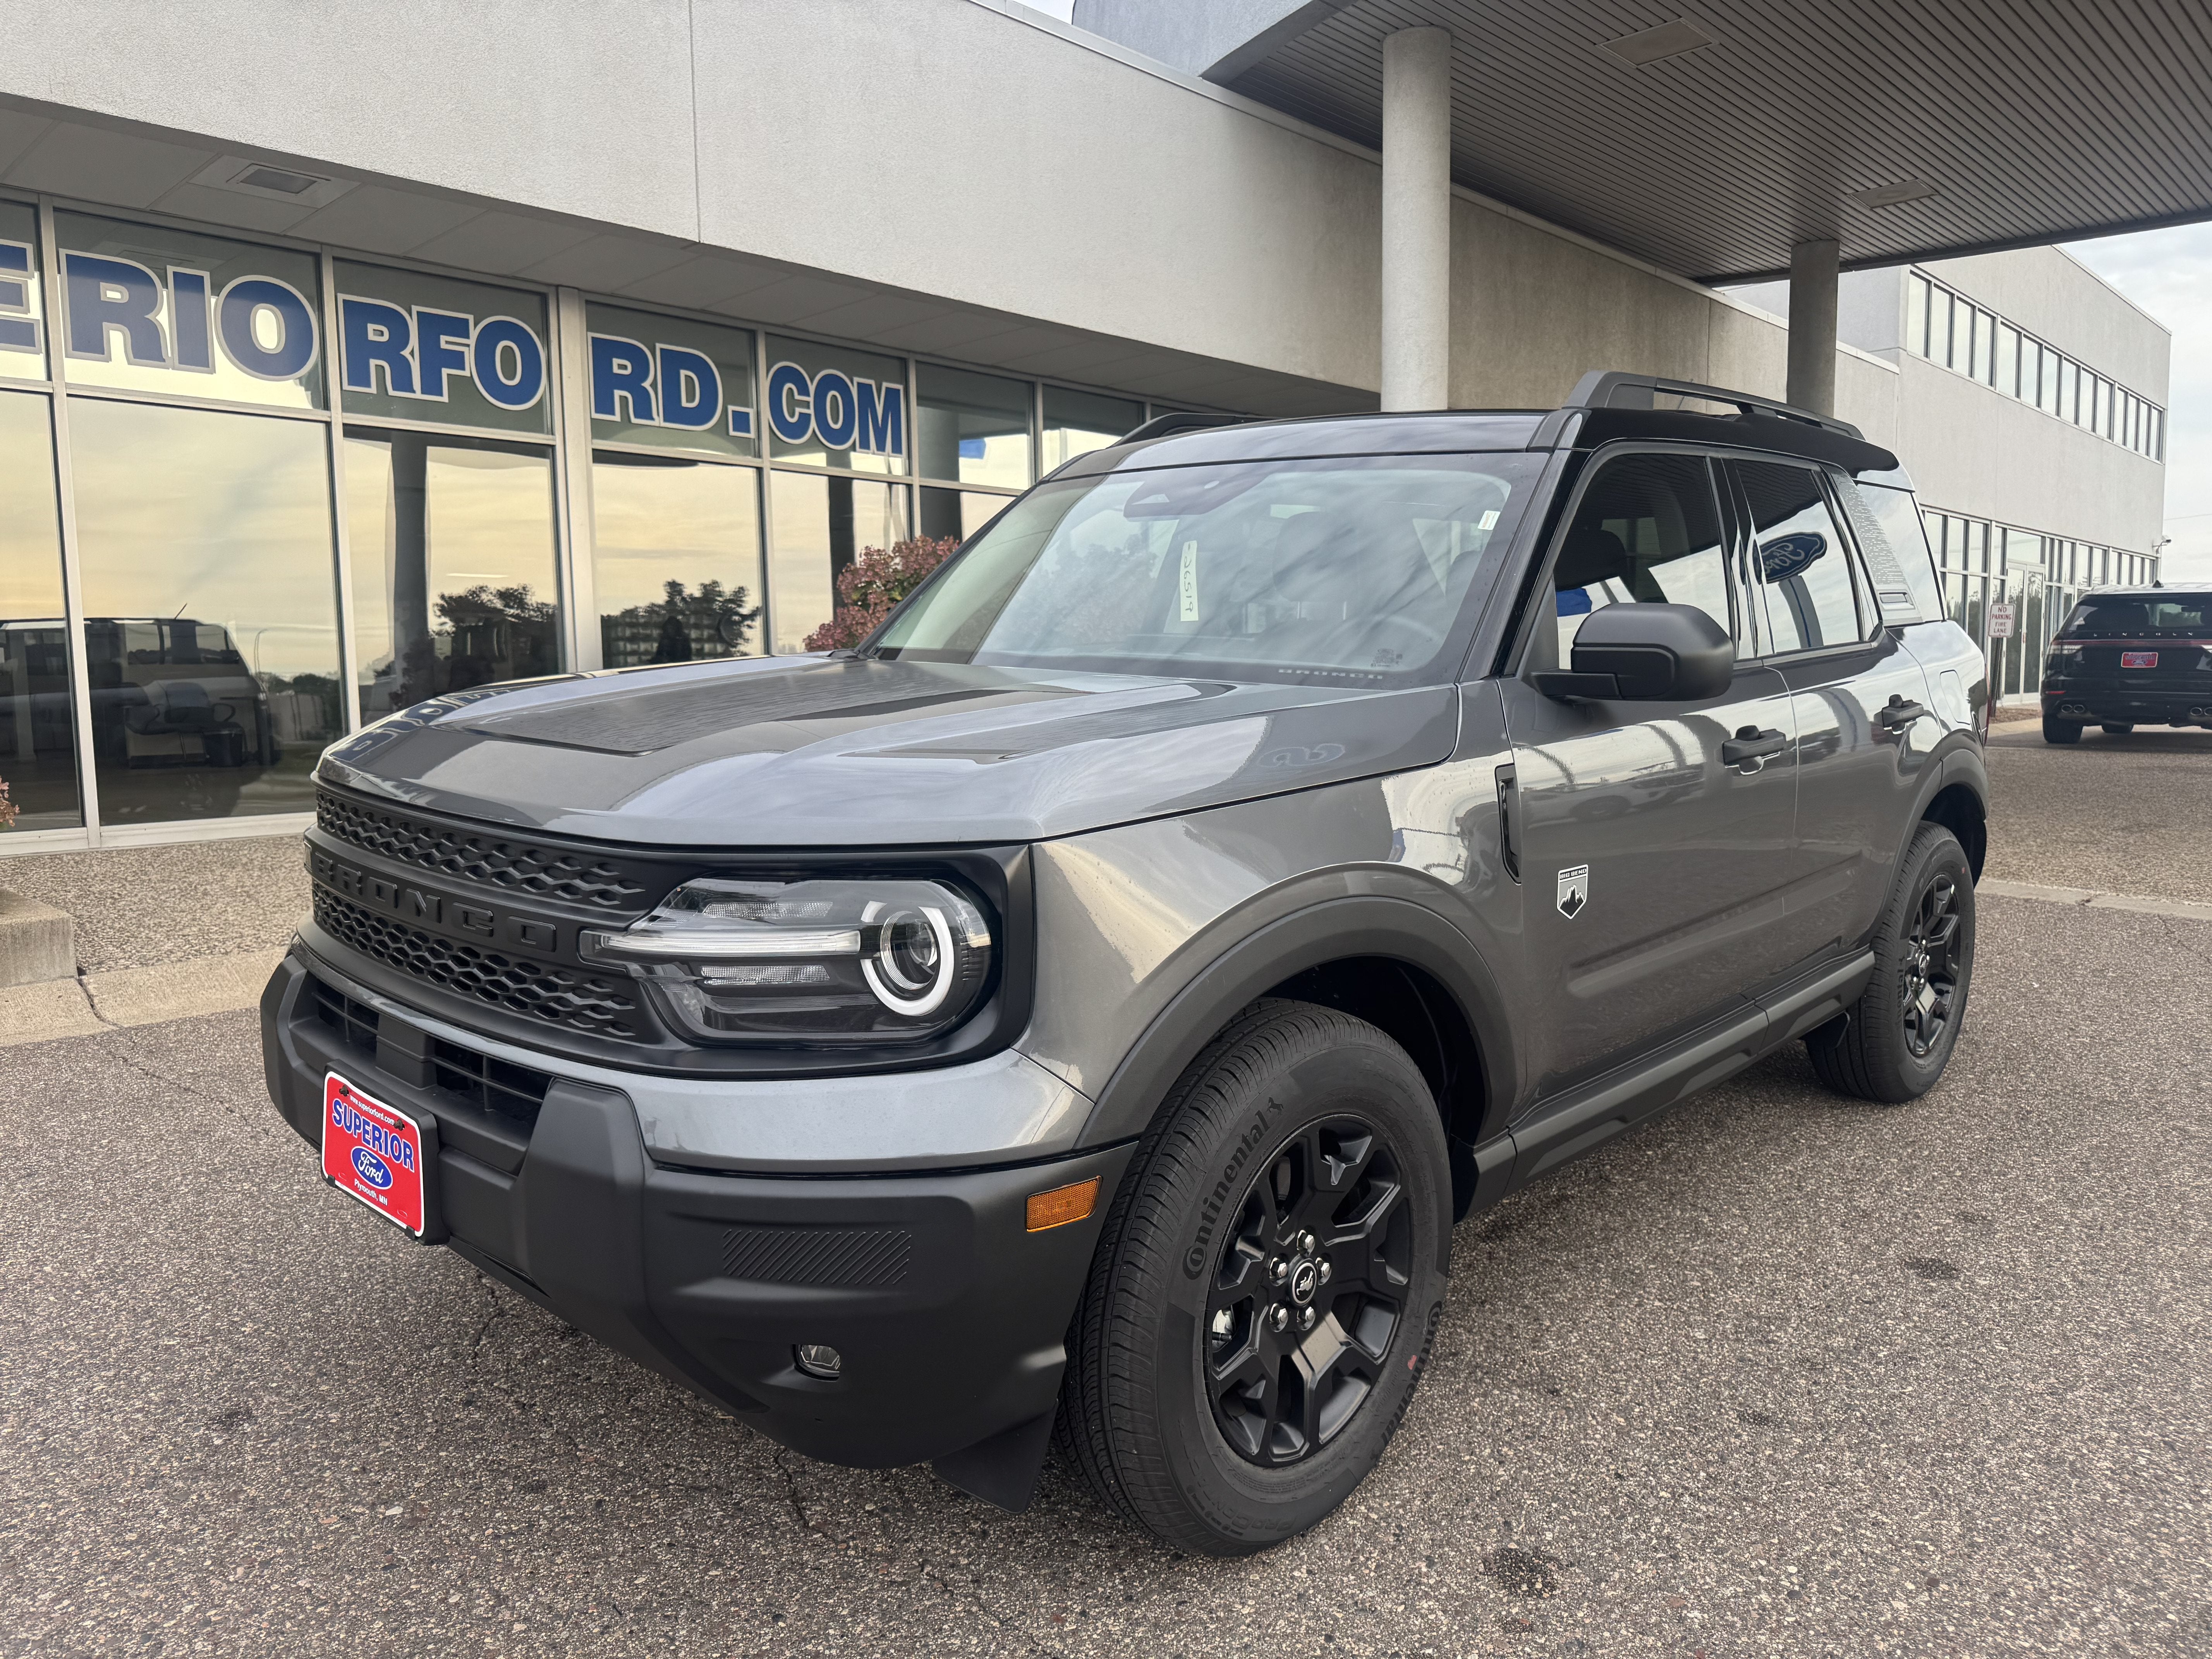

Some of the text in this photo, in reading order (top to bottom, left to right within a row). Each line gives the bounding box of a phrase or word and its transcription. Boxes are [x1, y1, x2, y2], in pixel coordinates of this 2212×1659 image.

[1571, 868, 1587, 877] BEND
[313, 851, 557, 953] BRONCO
[332, 1098, 415, 1173] SUPERIOR
[354, 1178, 388, 1206] Plymouth, MN
[358, 1151, 384, 1184] Ford
[1182, 1110, 1270, 1281] Continental
